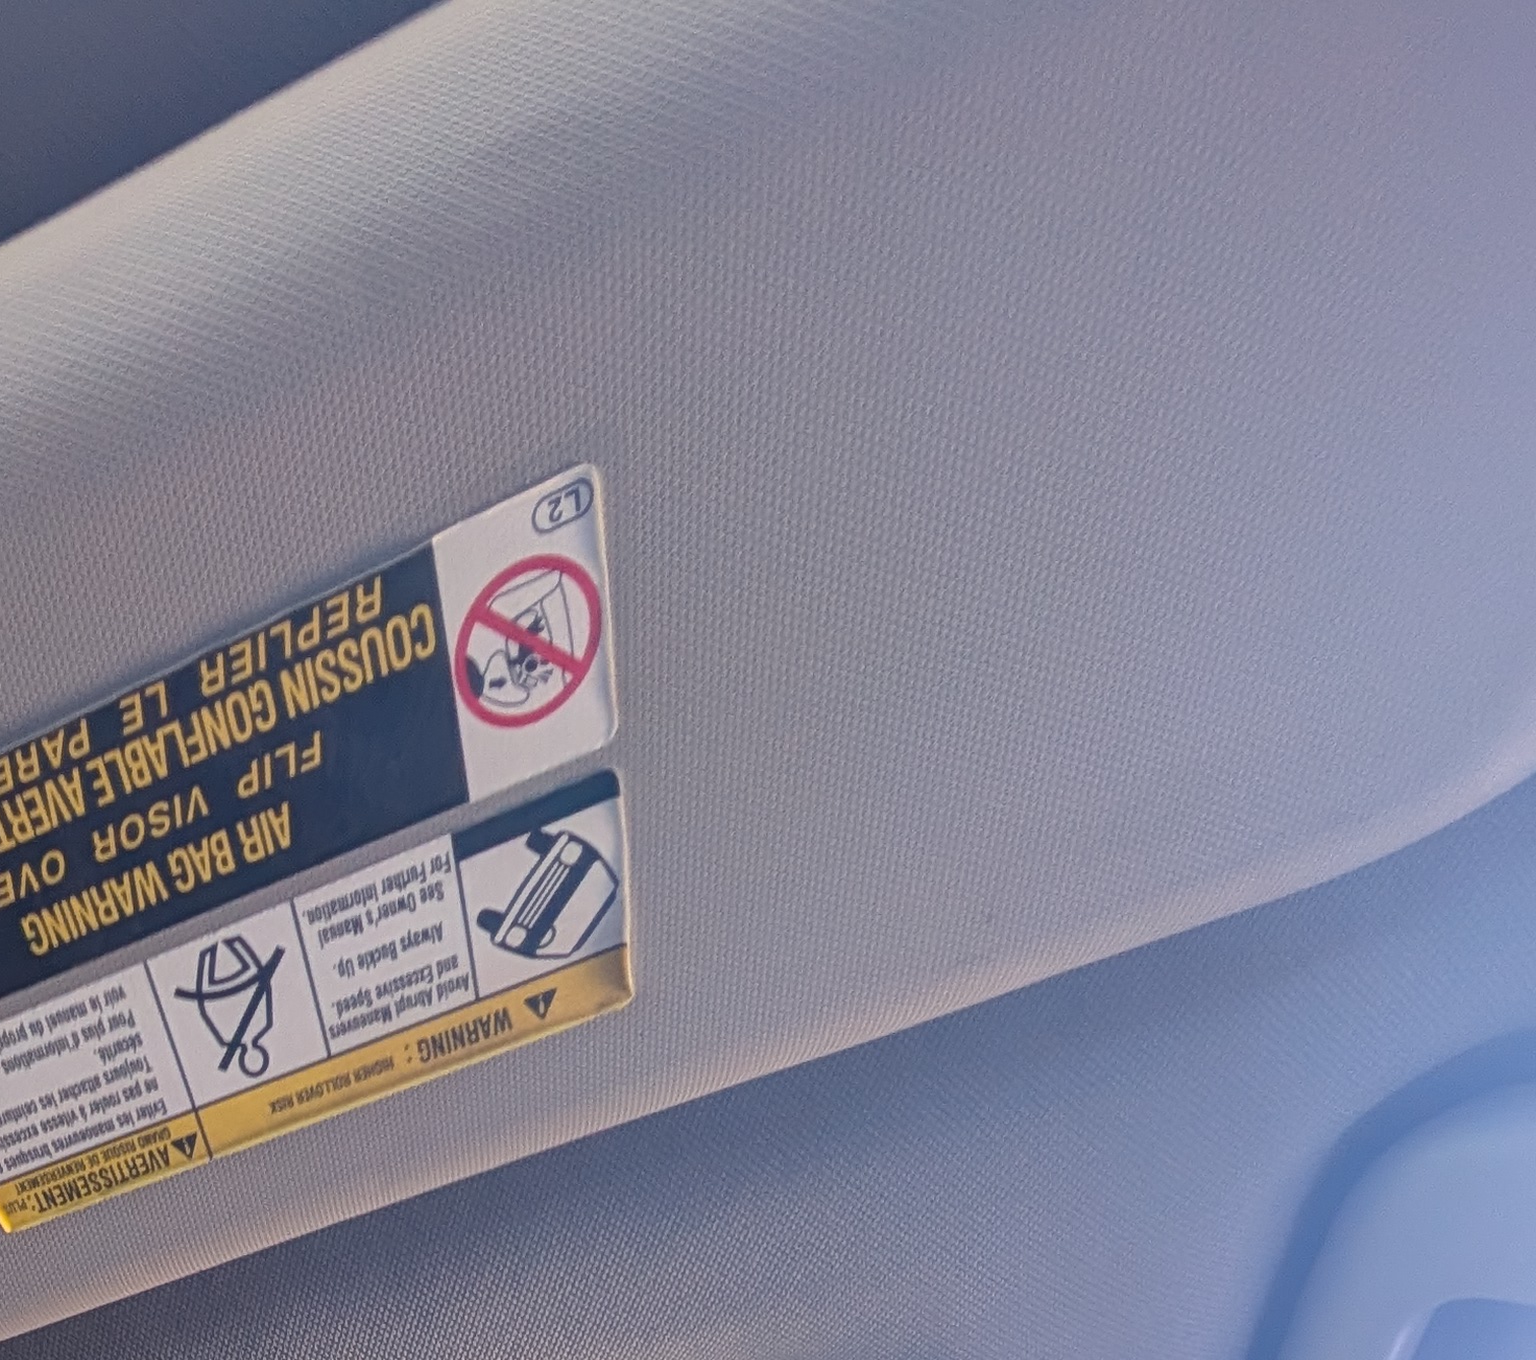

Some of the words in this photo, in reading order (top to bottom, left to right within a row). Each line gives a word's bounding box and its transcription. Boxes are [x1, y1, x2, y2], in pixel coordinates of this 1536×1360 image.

[548, 485, 583, 522] L2
[200, 575, 383, 698] REPLIER
[280, 603, 436, 720] COUSSIN
[120, 681, 168, 735] LE
[87, 688, 277, 807] GONFLABLE
[238, 730, 322, 799] FLIP
[93, 786, 209, 862] VISOR
[238, 801, 292, 863] AIR
[167, 828, 236, 893] BAG
[430, 851, 452, 874] For
[381, 862, 427, 895] Further
[419, 881, 445, 904] See
[21, 861, 169, 952] WARNING
[302, 883, 379, 926] Information.
[365, 892, 417, 928] Owner's
[318, 914, 364, 950] Manual
[400, 921, 443, 953] Always
[333, 957, 356, 980] Up.
[357, 940, 398, 971] Buckle
[436, 954, 459, 980] and
[103, 985, 127, 1010] voir
[375, 965, 434, 1000] Excessive
[436, 972, 470, 1002] Avoid
[45, 1002, 88, 1034] manuel
[89, 995, 103, 1015] le
[331, 988, 373, 1020] Speed.
[394, 987, 433, 1018] Abrupt
[28, 1020, 44, 1037] du
[80, 1016, 106, 1043] plus
[107, 1009, 136, 1033] Pour
[328, 1003, 393, 1040] Maneuvers
[102, 1056, 154, 1085] Toujours
[144, 1076, 158, 1094] ne
[39, 1092, 58, 1110] les
[58, 1073, 102, 1103] attacher
[89, 1091, 122, 1115] rouler
[122, 1080, 143, 1103] pas
[296, 1072, 352, 1106] ROLLOVER
[116, 1111, 135, 1128] les
[269, 1093, 295, 1115] RISK
[40, 1109, 79, 1134] vitesse
[51, 1119, 115, 1153] manoeuvres
[100, 1139, 136, 1161] RISQUE
[137, 1127, 172, 1148] GRAND
[3, 1143, 53, 1172] brusques
[87, 1154, 100, 1166] DE
[14, 1163, 86, 1195] RENVERSEMENT
[27, 1145, 171, 1213] AVERTISSEMENT:
